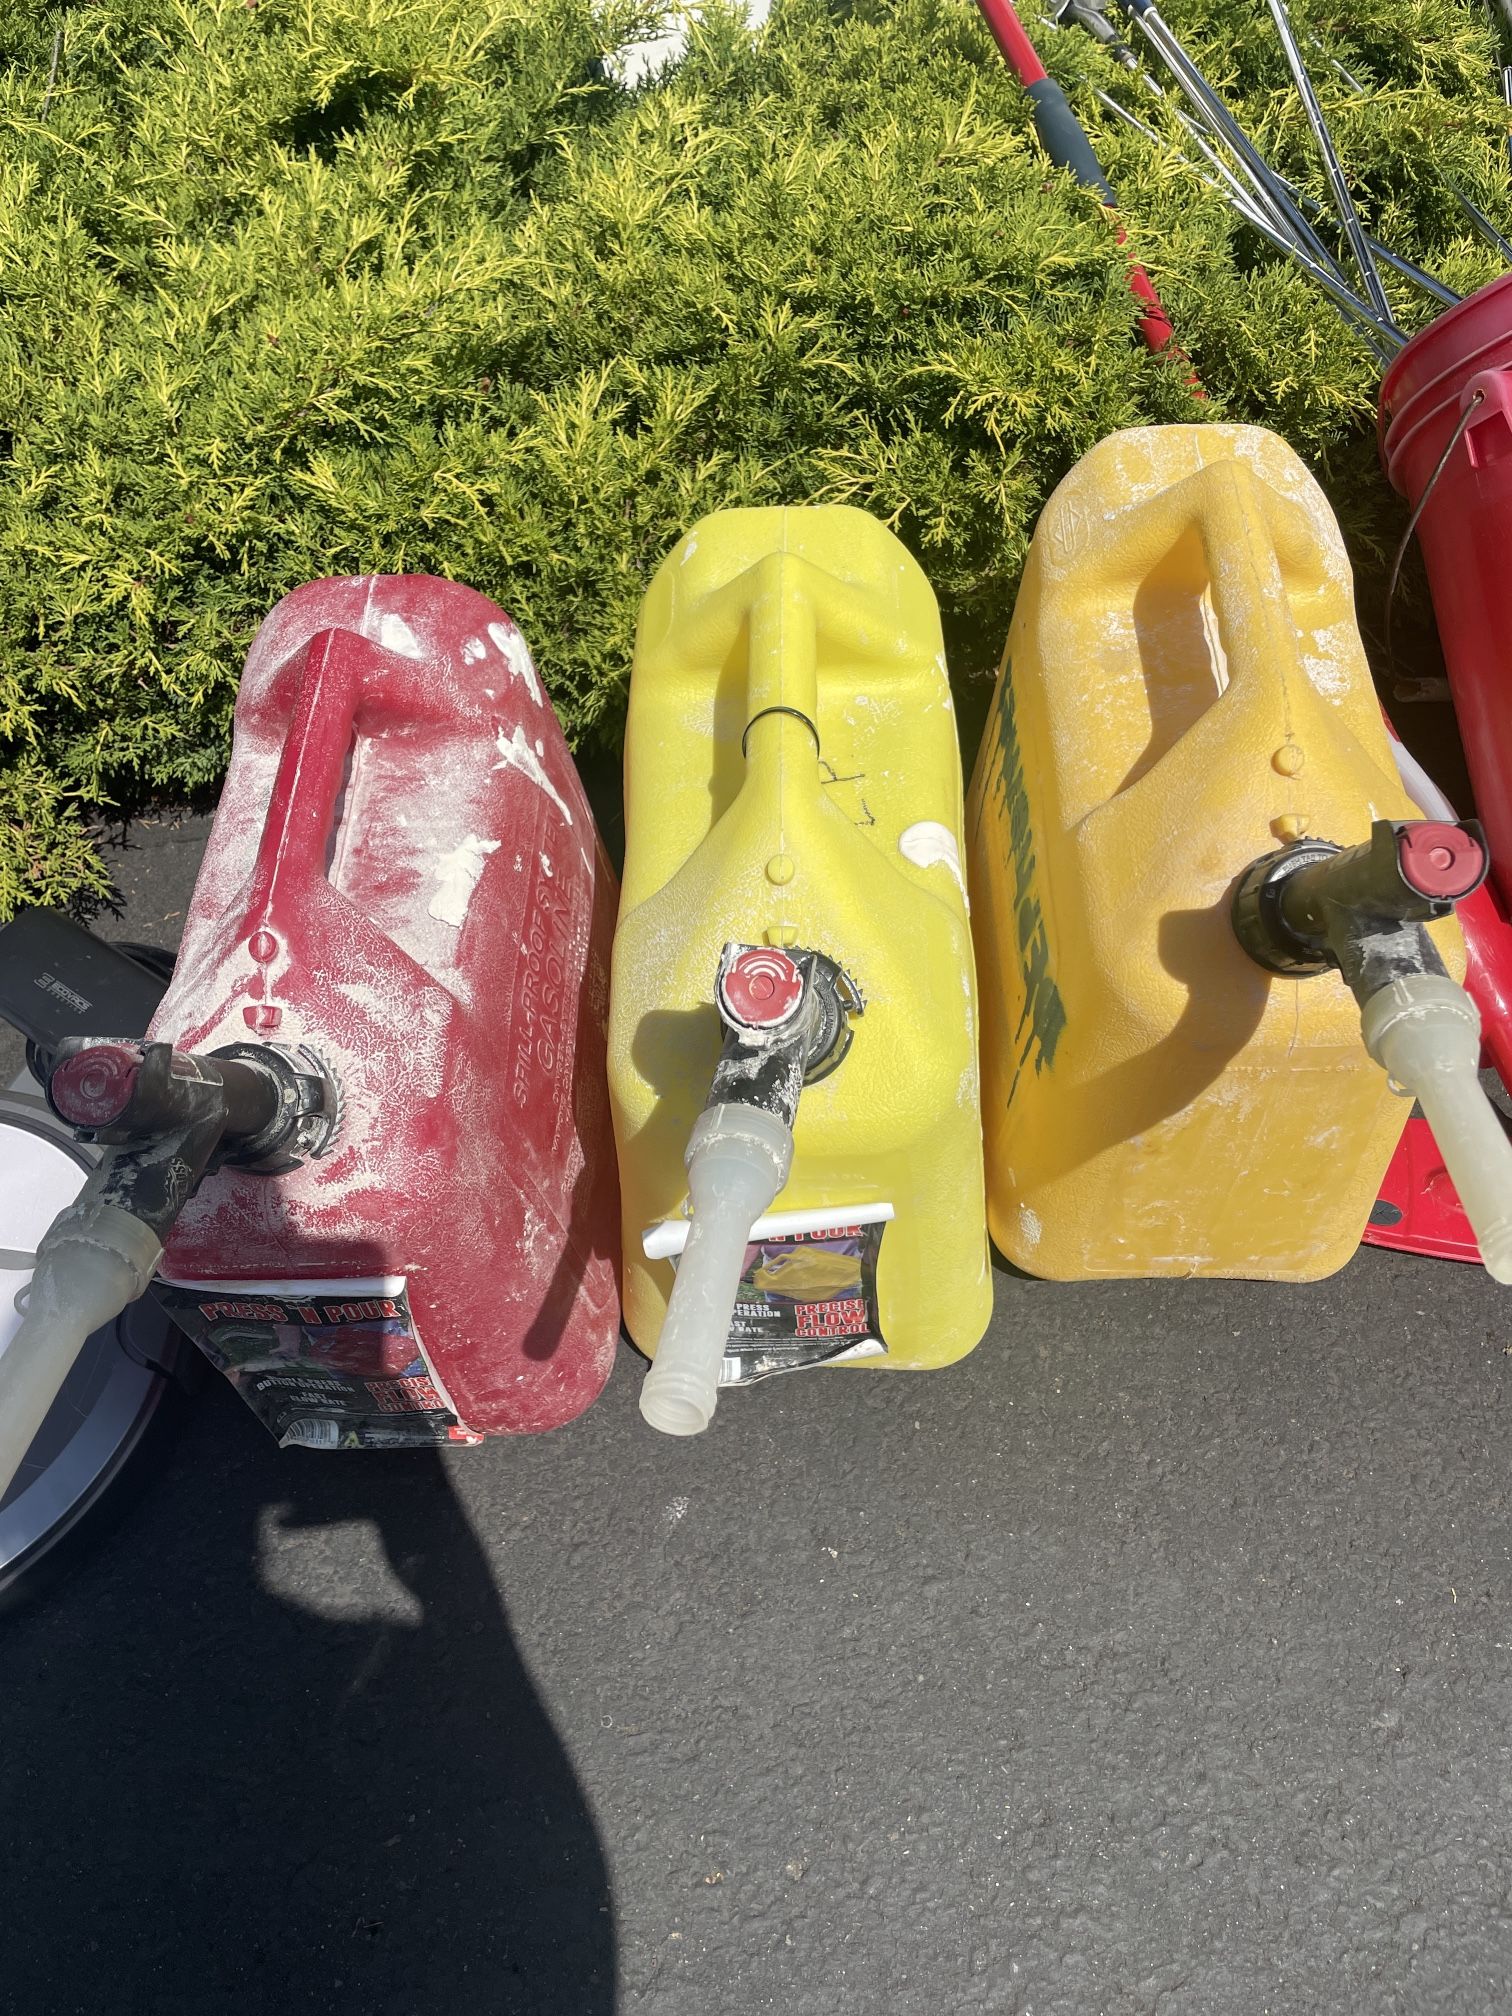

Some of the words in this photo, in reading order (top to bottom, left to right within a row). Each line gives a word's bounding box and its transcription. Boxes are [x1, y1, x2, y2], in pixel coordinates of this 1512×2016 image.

[537, 874, 573, 1074] GASOLINE
[513, 912, 548, 1108] SPILL-PROOF
[199, 1301, 289, 1322] PRESS
[324, 1300, 402, 1323] POUR
[735, 1303, 770, 1311] PRESS
[794, 1298, 865, 1315] PRECISE
[796, 1309, 867, 1329] FLOW
[794, 1323, 871, 1338] CONTROL
[256, 1379, 295, 1391] BUTTON
[296, 1382, 356, 1393] OPERATION
[363, 1376, 433, 1392] PRECIS
[371, 1387, 441, 1404] FLOW
[378, 1399, 447, 1413] CONTRO
